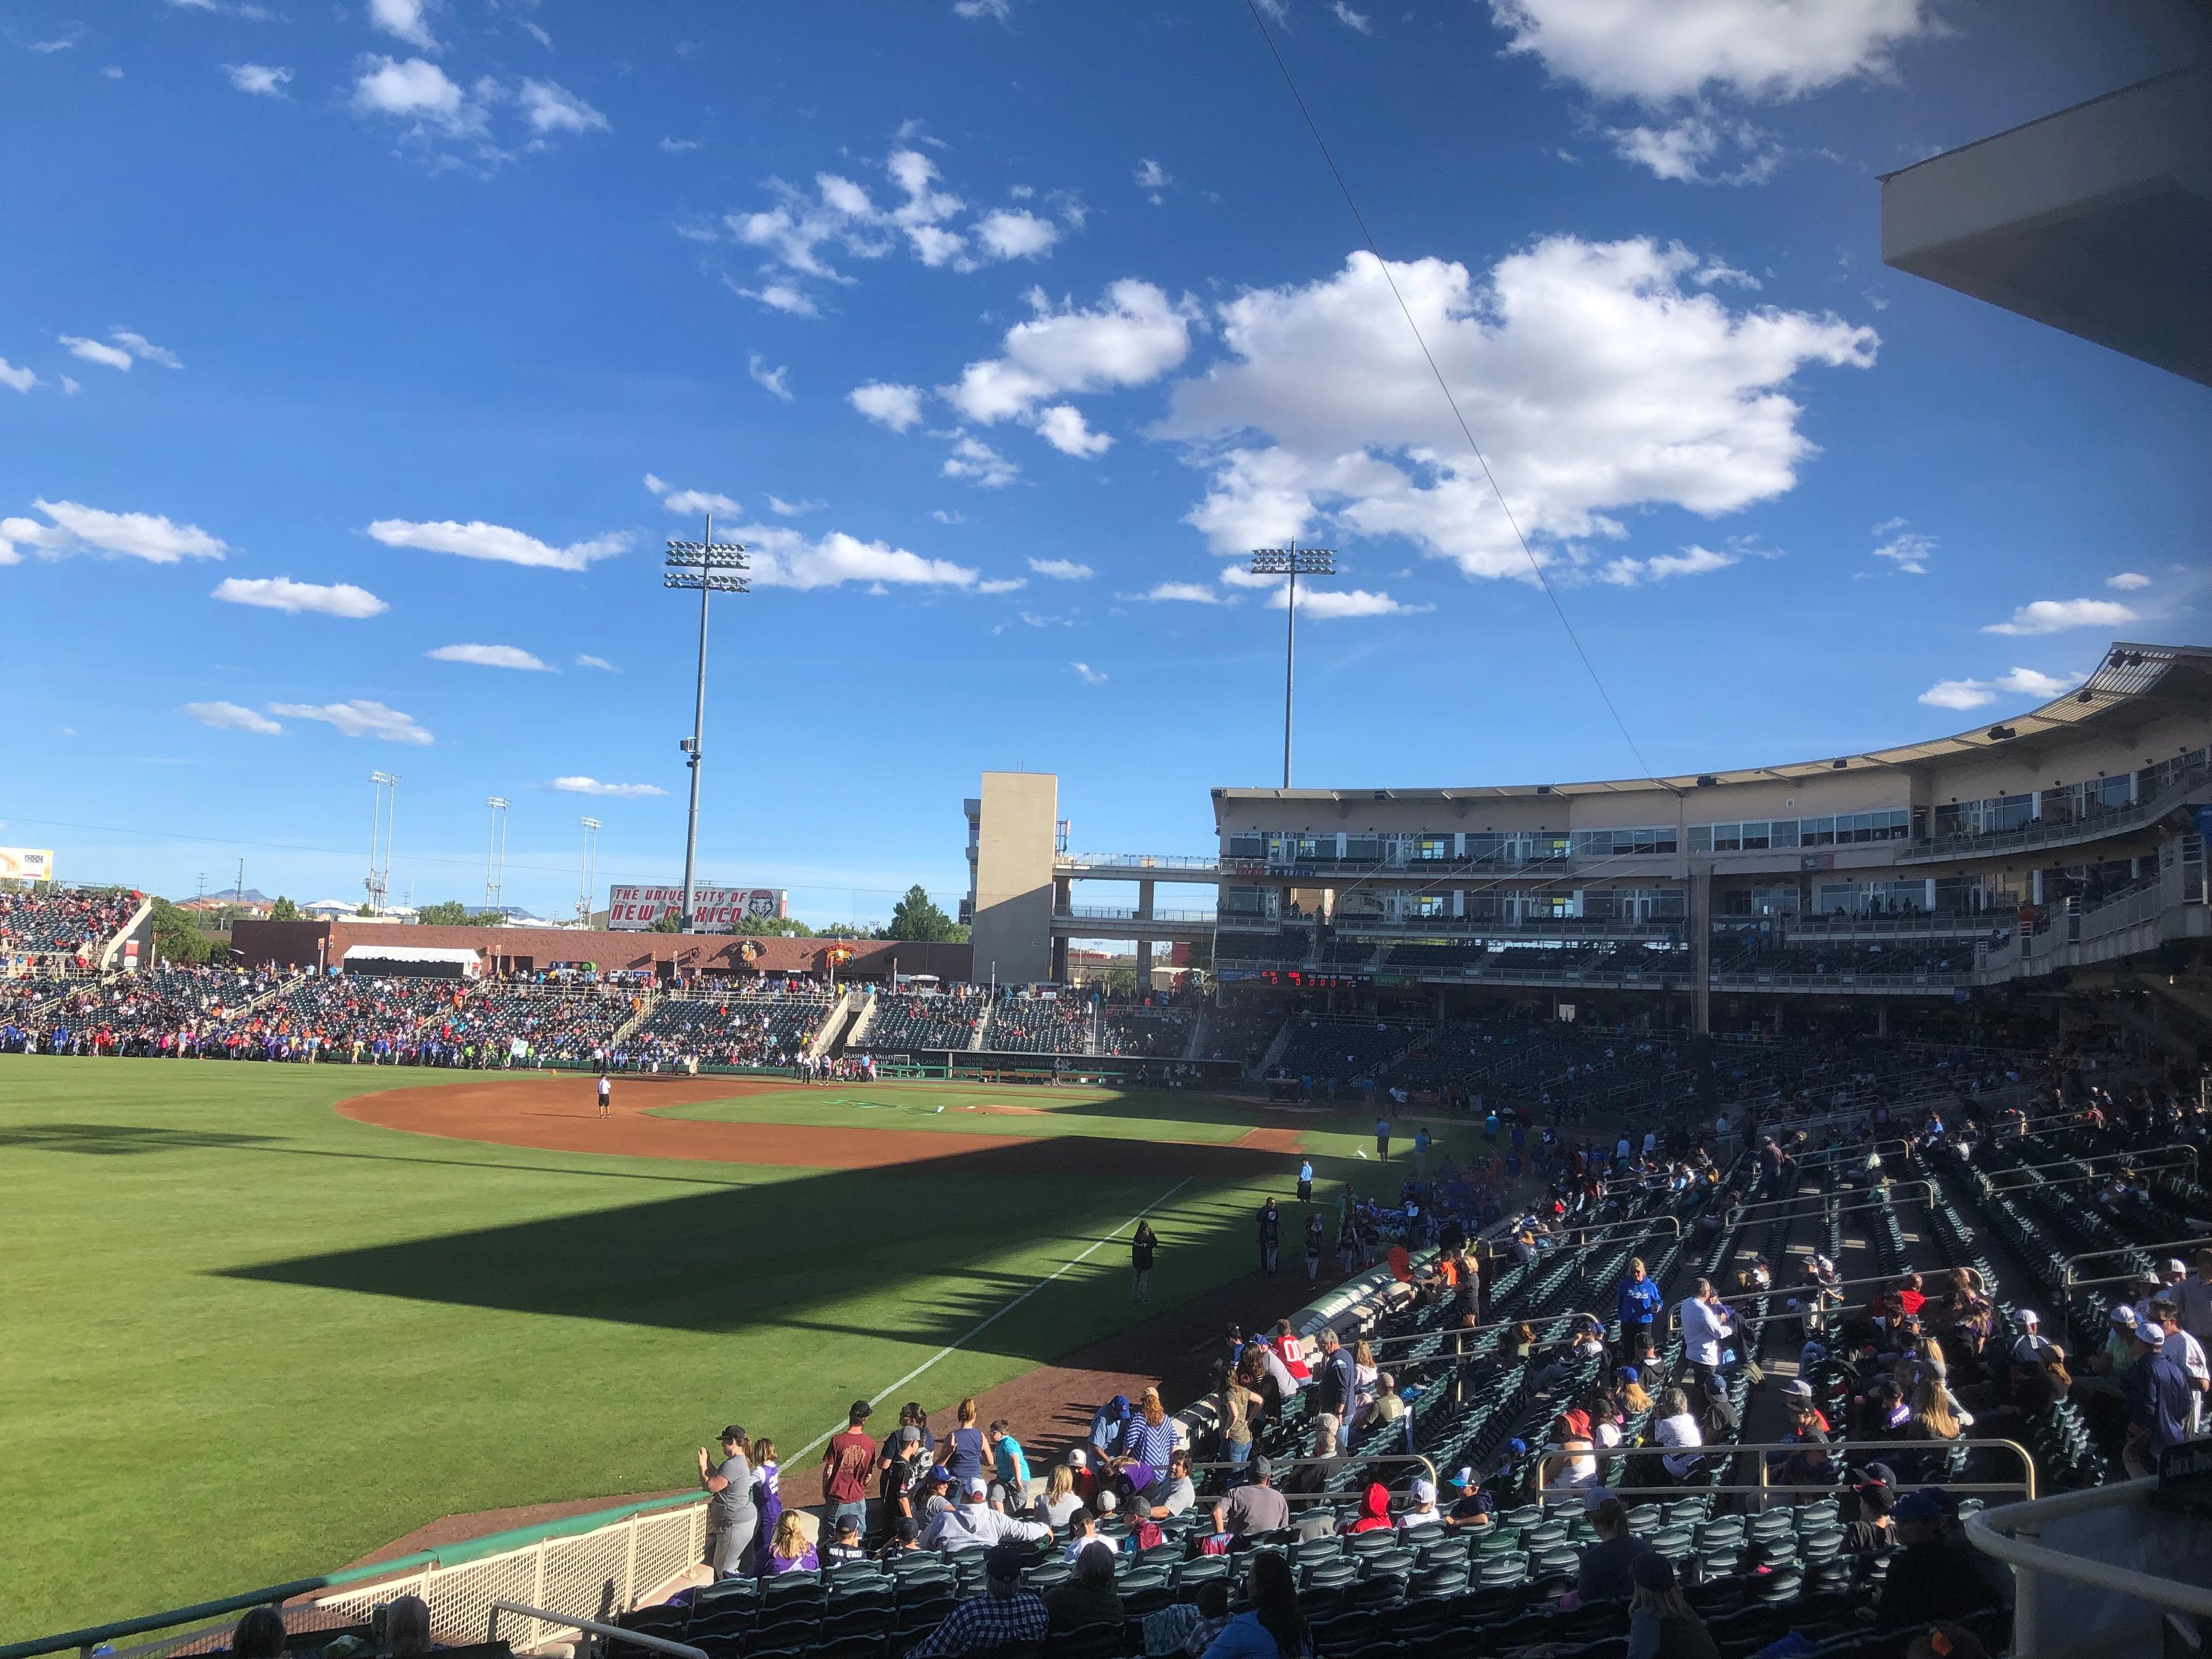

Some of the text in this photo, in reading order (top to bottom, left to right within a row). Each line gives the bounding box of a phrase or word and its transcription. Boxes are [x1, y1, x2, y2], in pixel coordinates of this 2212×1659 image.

[616, 889, 747, 903] THE UNIVESITY OF
[611, 904, 743, 925] NEW MXICO
